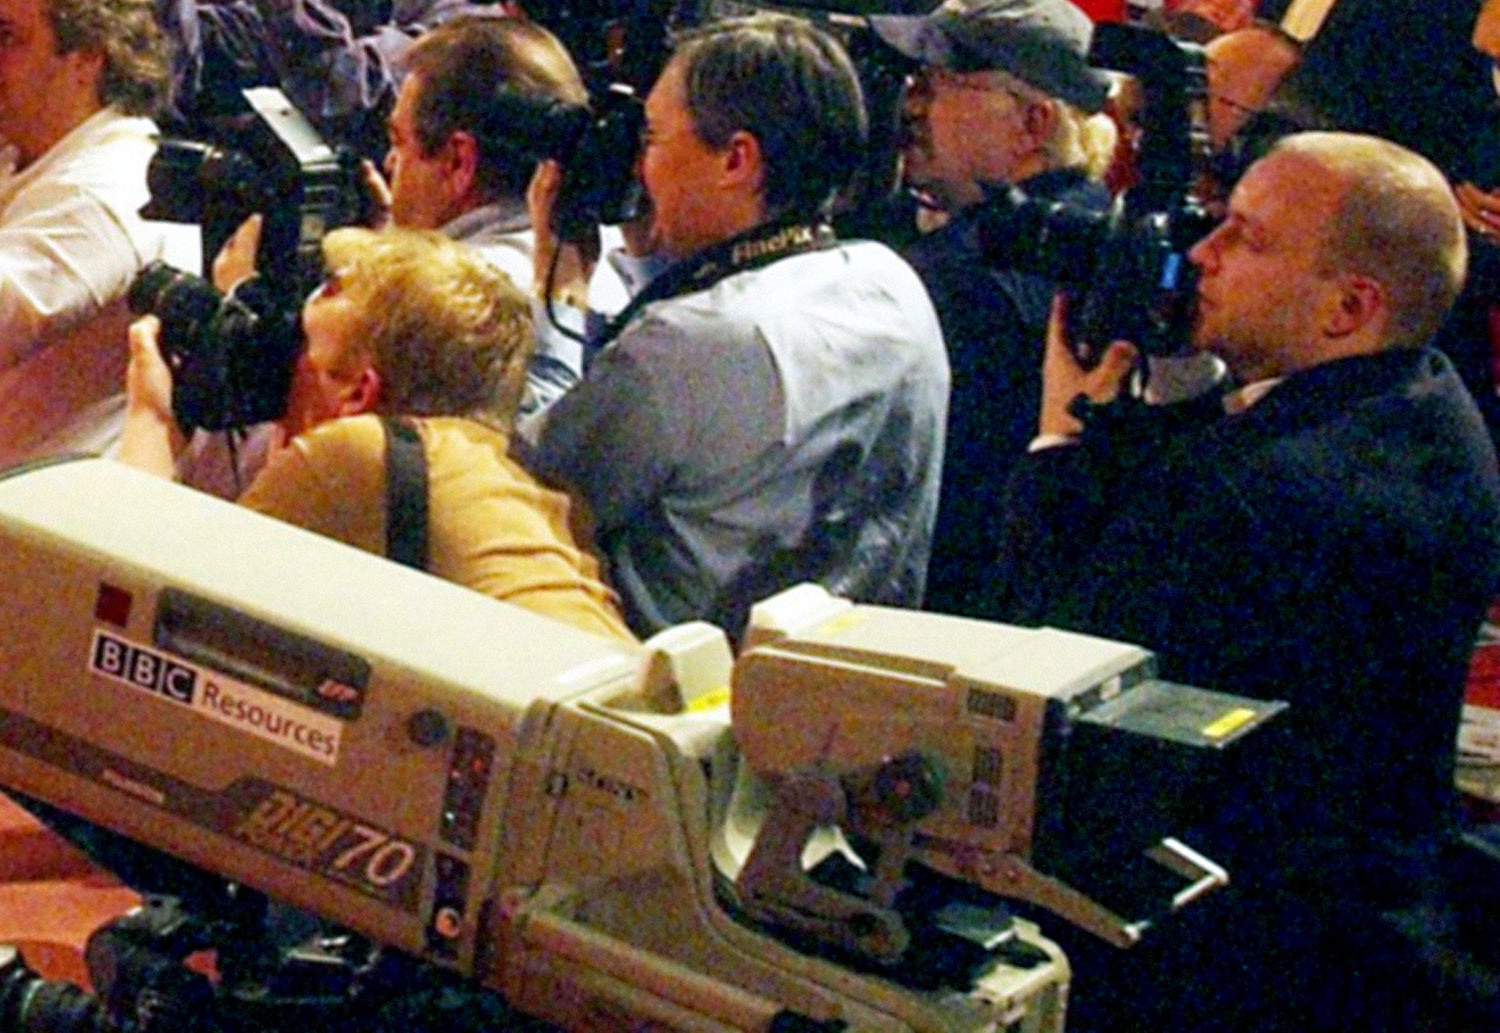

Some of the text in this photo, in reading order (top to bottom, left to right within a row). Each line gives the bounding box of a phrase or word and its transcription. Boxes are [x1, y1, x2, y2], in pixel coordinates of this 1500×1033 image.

[100, 641, 335, 755] BBC Resources
[334, 823, 416, 885] 70
